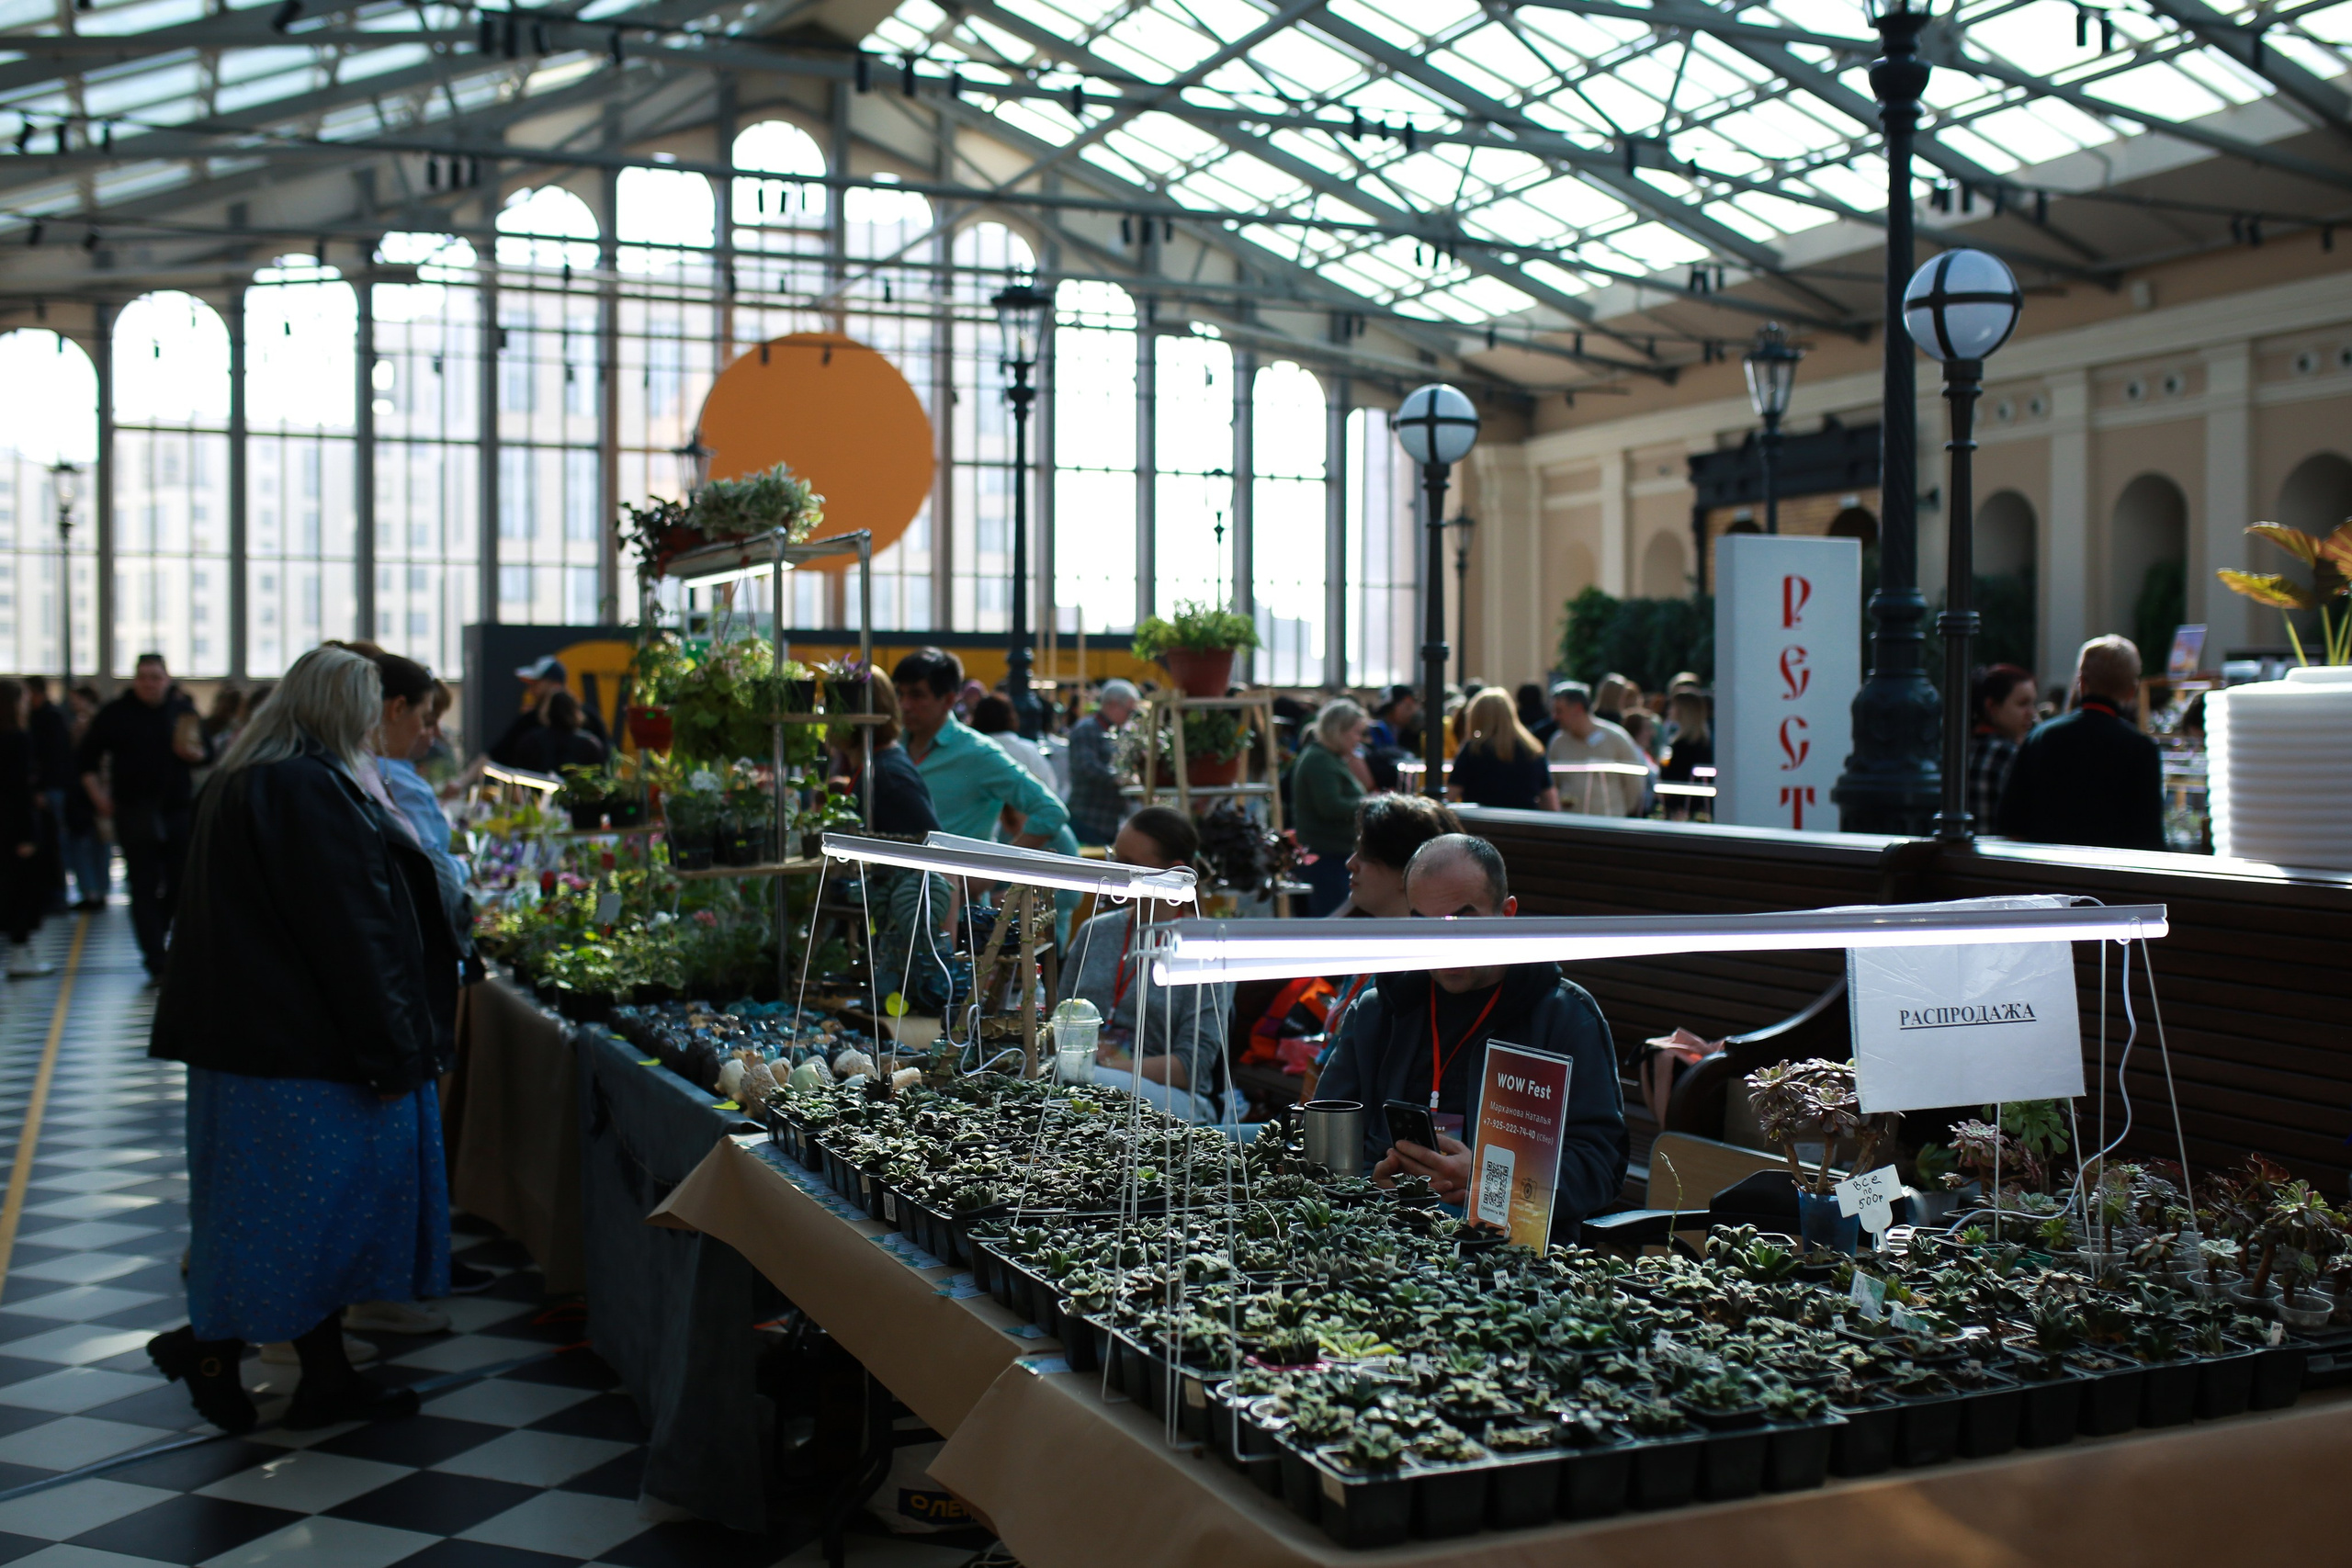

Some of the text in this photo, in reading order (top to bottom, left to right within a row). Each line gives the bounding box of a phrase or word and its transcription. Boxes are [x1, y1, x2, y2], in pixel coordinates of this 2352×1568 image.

[1899, 1002, 2036, 1028] РАСПРОДАЖА
[1498, 1072, 1551, 1100] WOW Fest
[1525, 1110, 1552, 1125] Наталья
